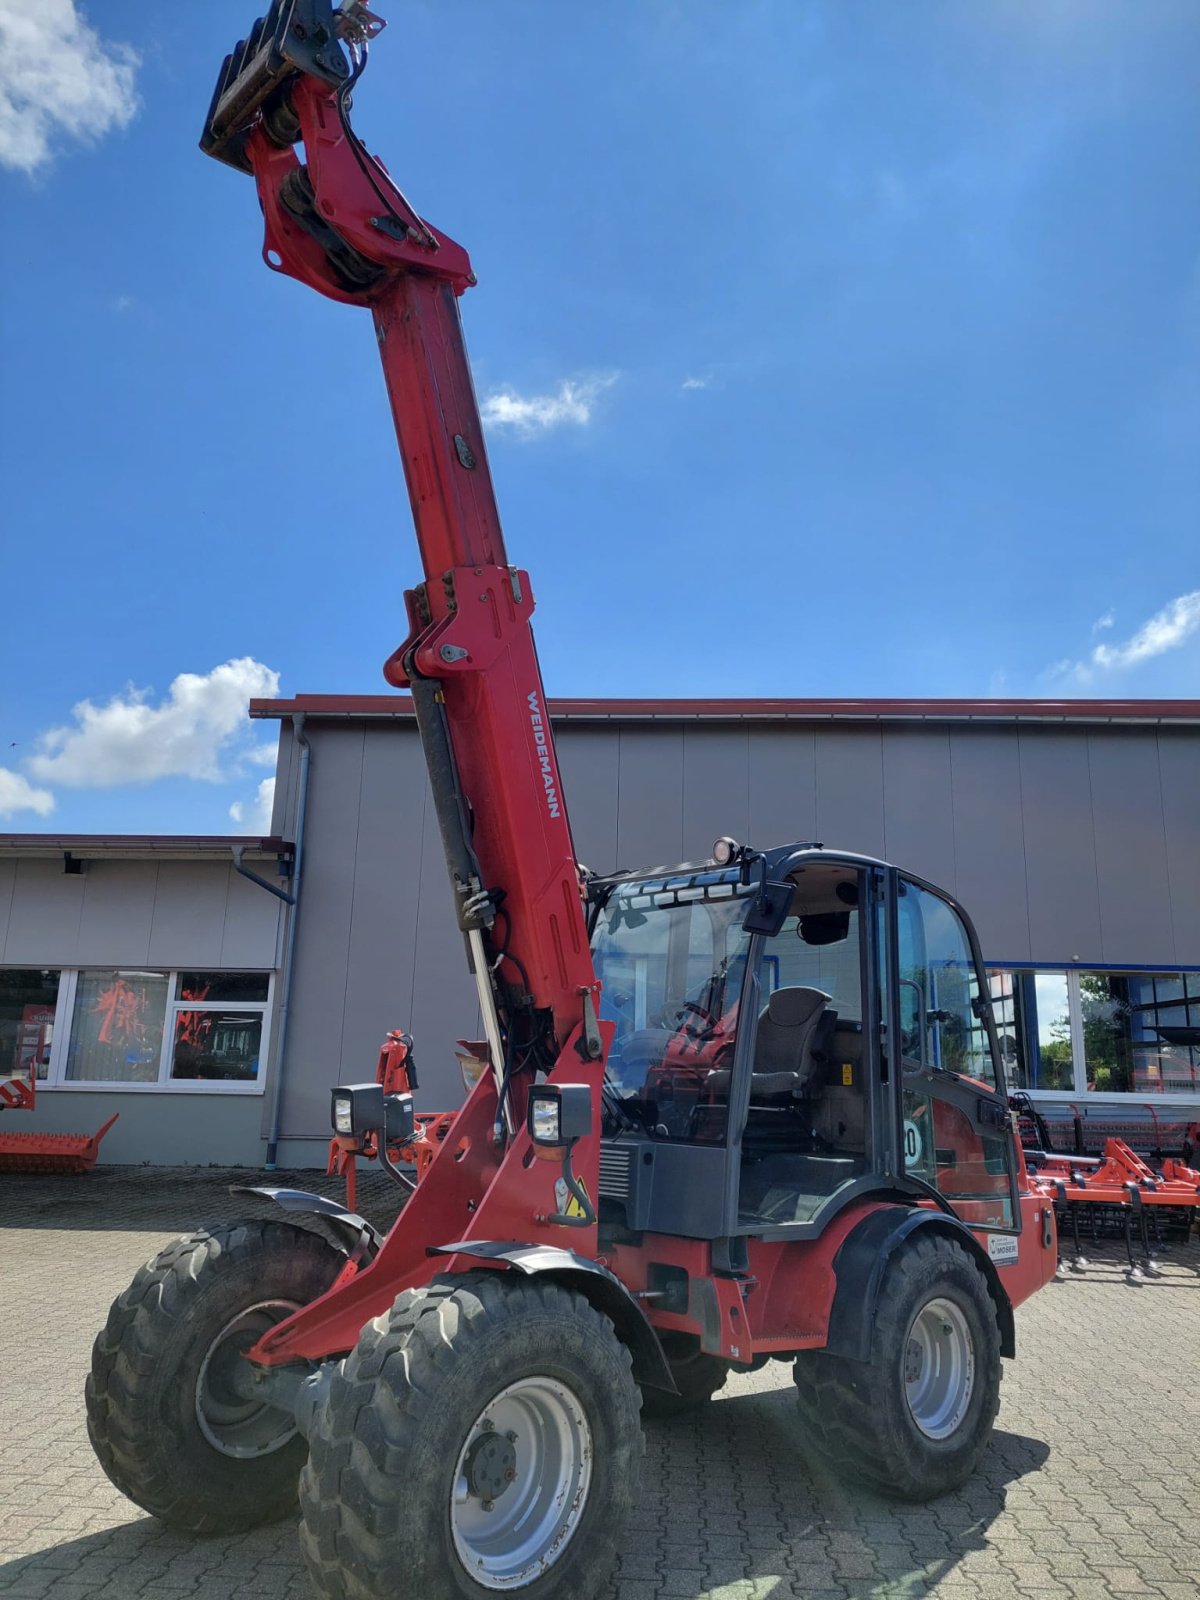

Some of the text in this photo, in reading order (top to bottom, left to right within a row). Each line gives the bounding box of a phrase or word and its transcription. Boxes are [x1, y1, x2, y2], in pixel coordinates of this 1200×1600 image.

[527, 690, 560, 818] WEIDEMANN
[904, 1128, 916, 1157] 0
[997, 1245, 1016, 1254] MOSER
